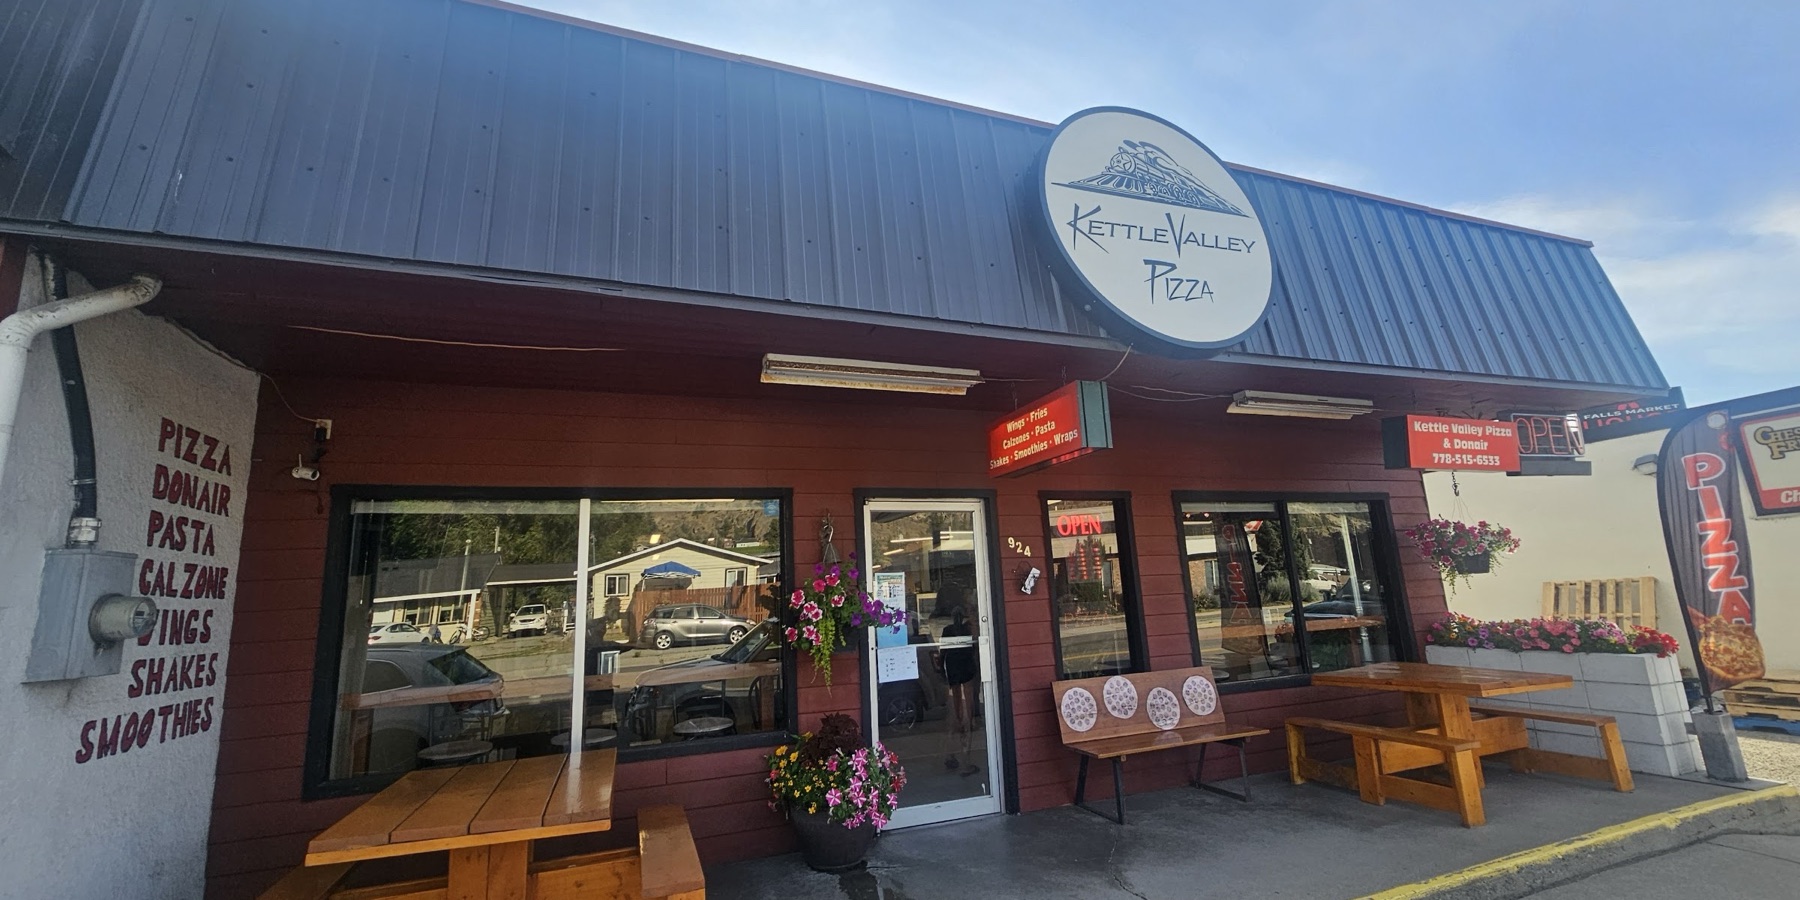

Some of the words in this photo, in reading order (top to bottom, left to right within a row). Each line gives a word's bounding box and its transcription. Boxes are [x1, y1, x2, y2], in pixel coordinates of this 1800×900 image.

[1143, 259, 1214, 304] PIZZA
[1006, 418, 1025, 433] Wings
[1030, 407, 1048, 422] Fries
[1414, 421, 1449, 433] Kettle
[1451, 423, 1483, 436] Valley
[1486, 425, 1512, 437] Pizza
[1583, 410, 1622, 420] FALLS
[1625, 403, 1679, 415] MARKET
[158, 416, 232, 477] PIZZA
[989, 455, 1009, 470] Shakes
[1014, 440, 1048, 460] Smoothies
[1054, 429, 1078, 446] Wraps
[1002, 431, 1030, 449] Calzones
[1035, 421, 1056, 436] Pasta
[1443, 438, 1451, 448] &
[1454, 439, 1488, 450] Donair
[1516, 416, 1585, 455] OPEN
[152, 463, 232, 518] DONAIR
[147, 510, 216, 556] PASTA
[1057, 514, 1102, 536] OPEN
[1681, 452, 1752, 626] PIZZA
[1008, 536, 1031, 557] 924
[138, 559, 229, 600] CALZONE
[128, 653, 219, 699] SHAKES
[75, 697, 214, 764] SMOOTHIES
